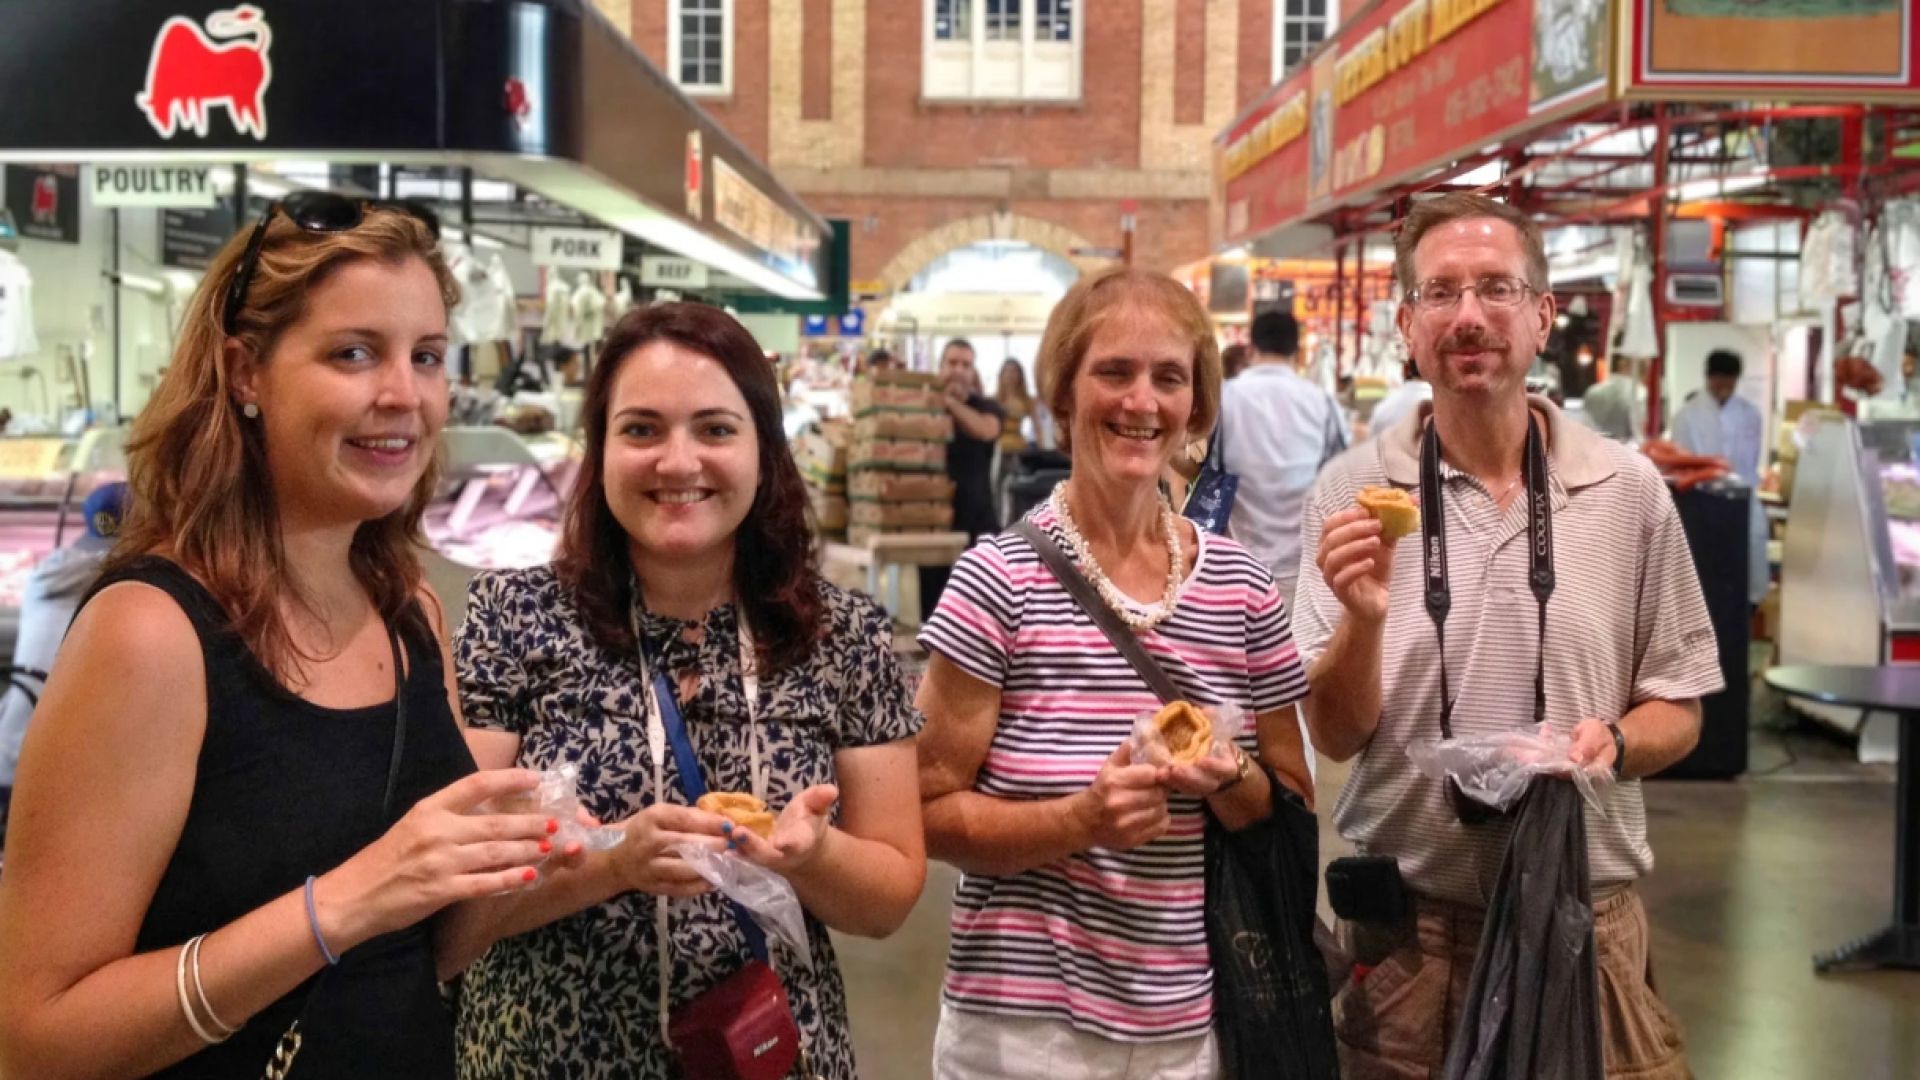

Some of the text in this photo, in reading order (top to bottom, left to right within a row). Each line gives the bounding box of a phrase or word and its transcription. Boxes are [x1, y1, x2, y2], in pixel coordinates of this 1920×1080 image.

[96, 167, 208, 193] POULTRY
[551, 238, 602, 258] PORK
[656, 264, 691, 279] BEEF
[1533, 490, 1546, 556] COOLPIX
[1429, 536, 1442, 578] Nikon
